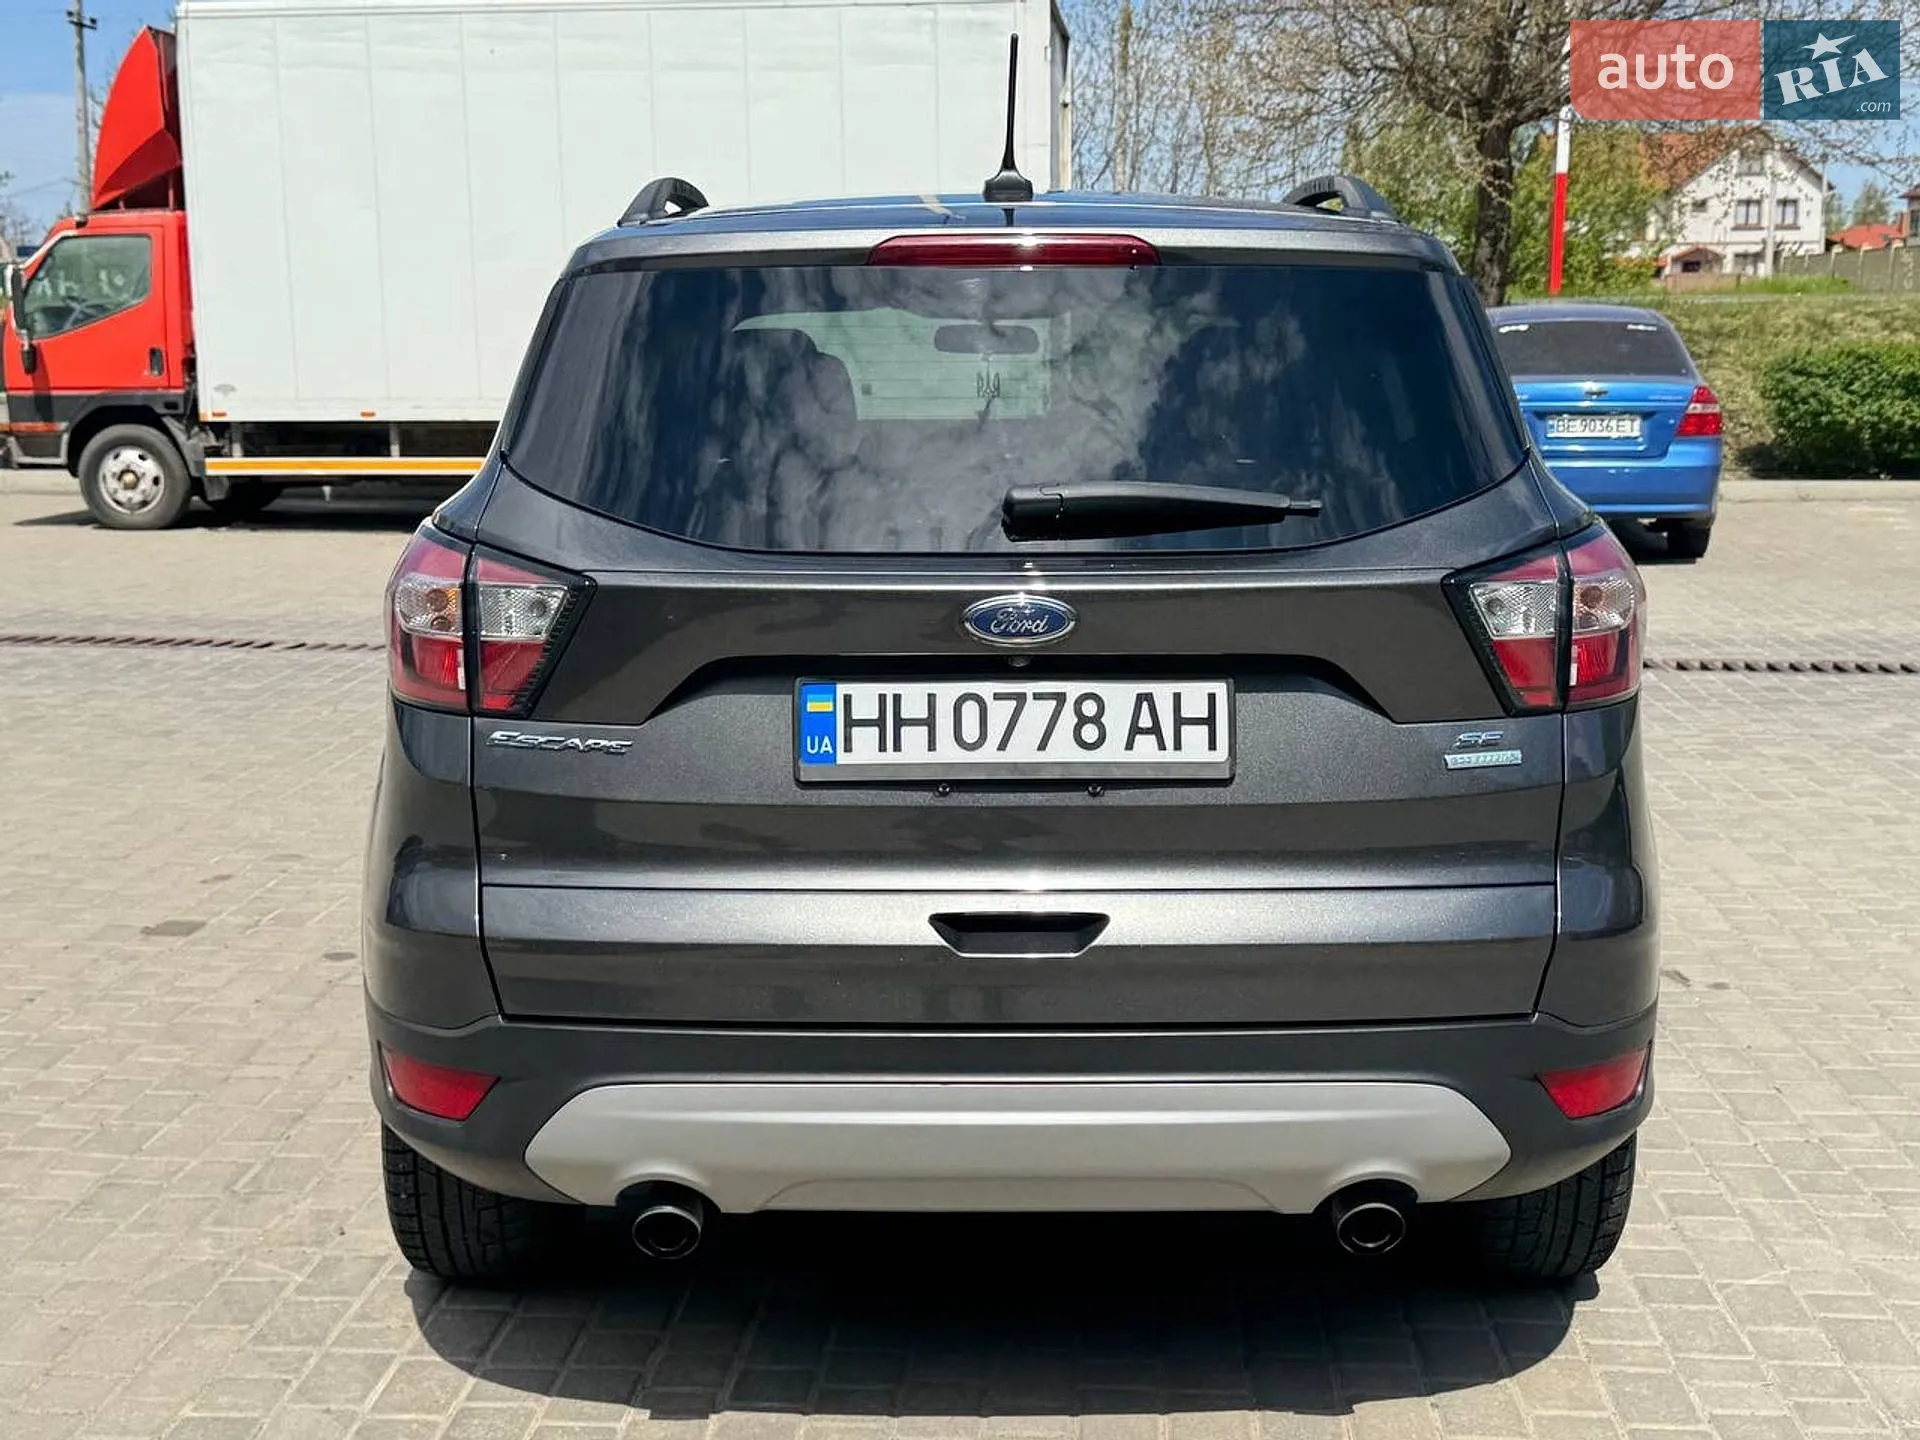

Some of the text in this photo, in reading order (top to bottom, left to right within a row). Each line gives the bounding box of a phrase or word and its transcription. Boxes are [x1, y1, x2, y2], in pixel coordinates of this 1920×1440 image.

[1556, 418, 1578, 433] BE
[1580, 418, 1614, 433] 9036
[989, 607, 1050, 634] Ford
[842, 692, 1218, 752] HH 0778 AH
[487, 730, 633, 754] ESCAPE
[806, 738, 833, 754] UA
